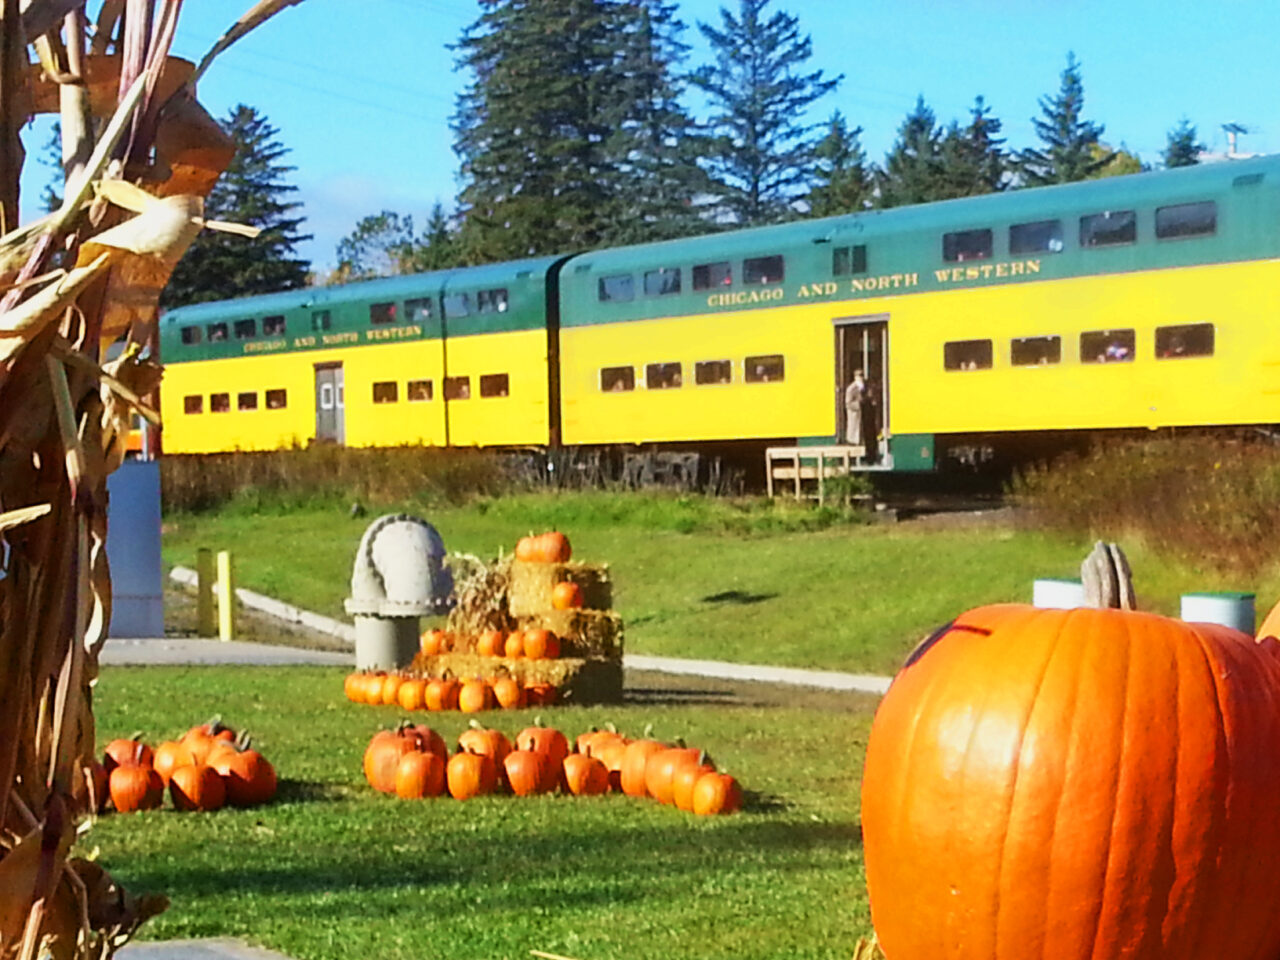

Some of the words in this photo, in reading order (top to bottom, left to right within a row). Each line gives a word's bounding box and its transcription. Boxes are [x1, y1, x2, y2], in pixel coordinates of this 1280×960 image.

[707, 288, 784, 307] CHICAGO
[797, 282, 837, 297] AND
[851, 273, 918, 292] NORTH
[935, 260, 1040, 283] WESTERN
